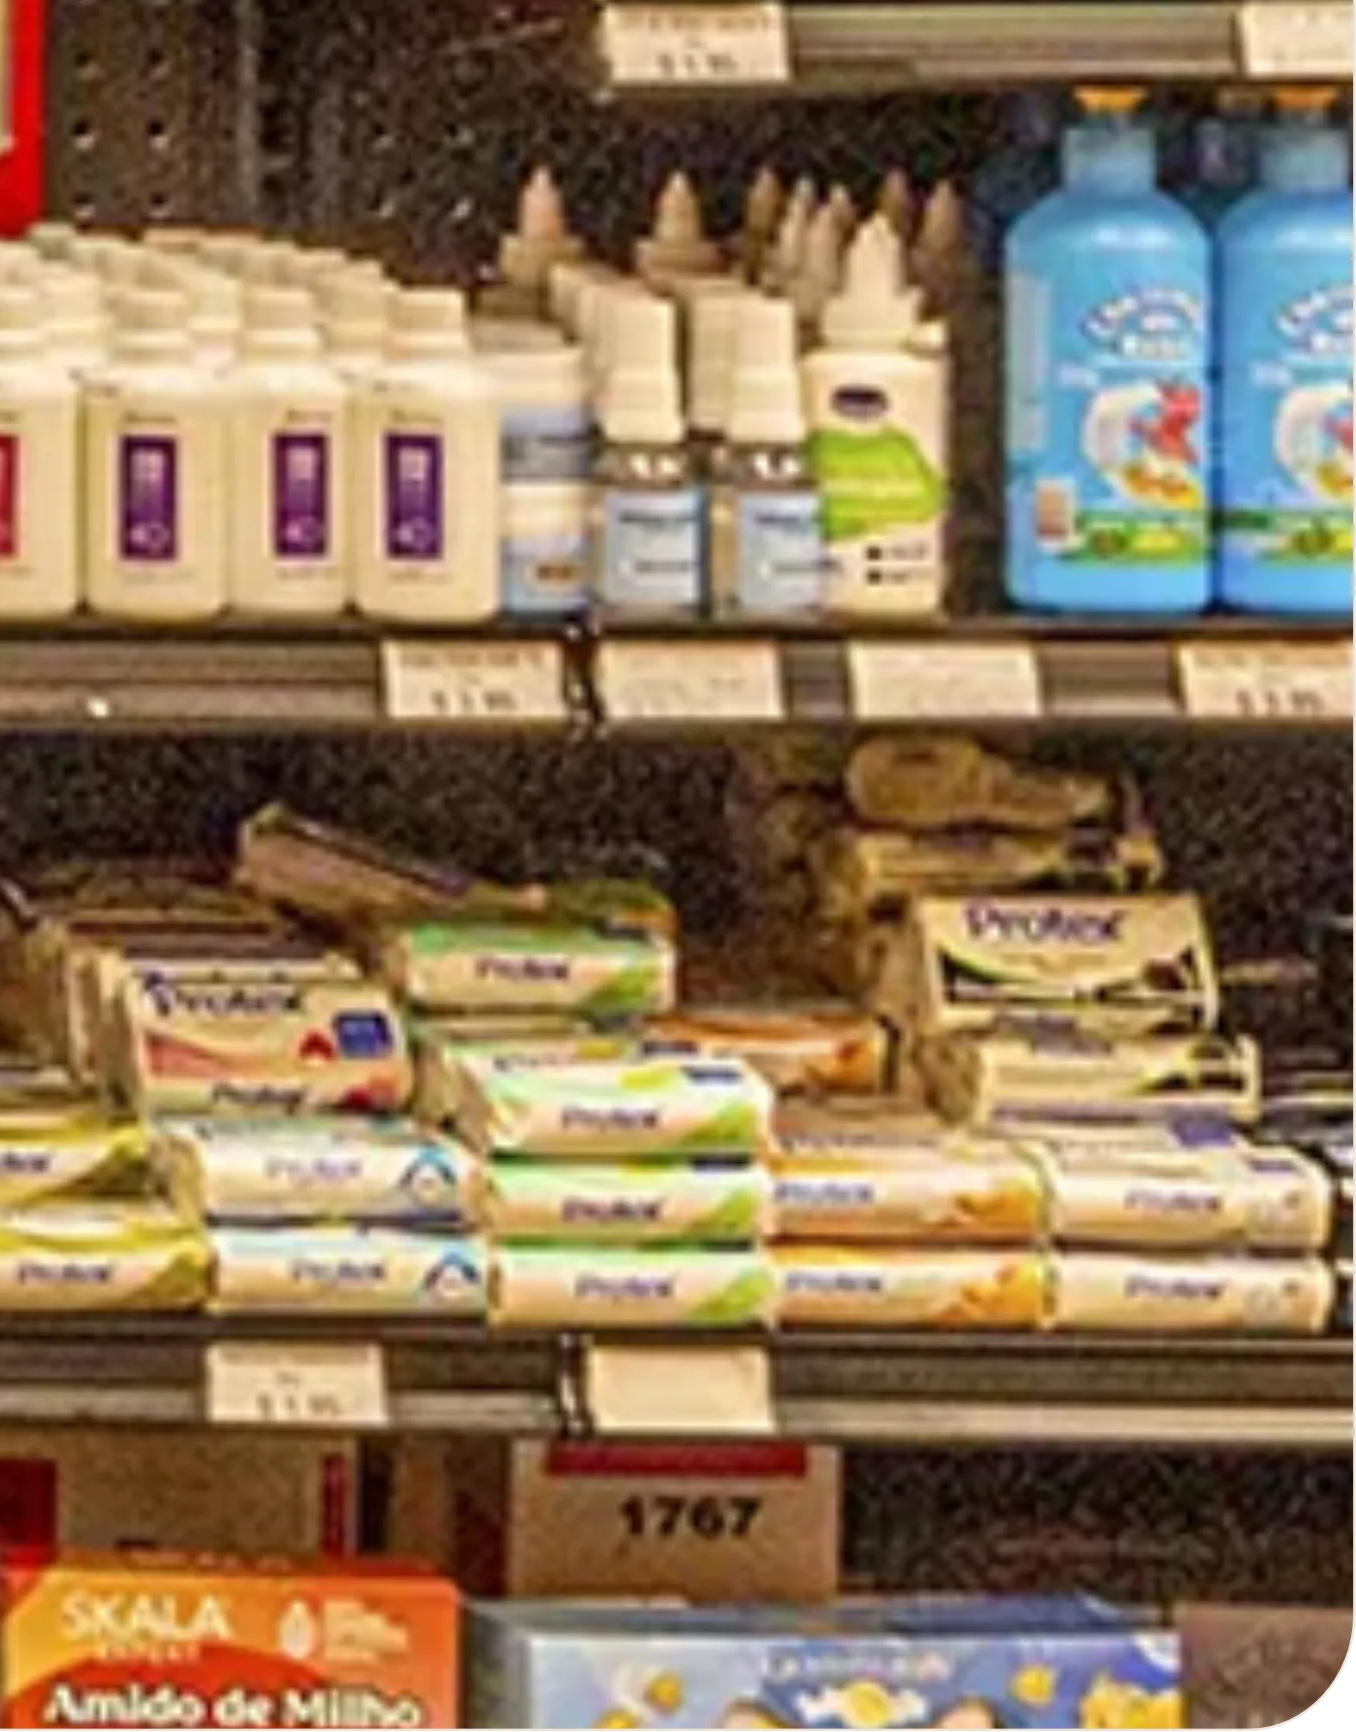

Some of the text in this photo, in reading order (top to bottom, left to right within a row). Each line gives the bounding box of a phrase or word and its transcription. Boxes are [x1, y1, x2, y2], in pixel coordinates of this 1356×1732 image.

[967, 904, 1125, 945] Protex
[139, 970, 302, 1016] Protex
[618, 1493, 764, 1539] 1767
[61, 1590, 236, 1642] SKALA
[44, 1679, 422, 1730] Amido de Milho
